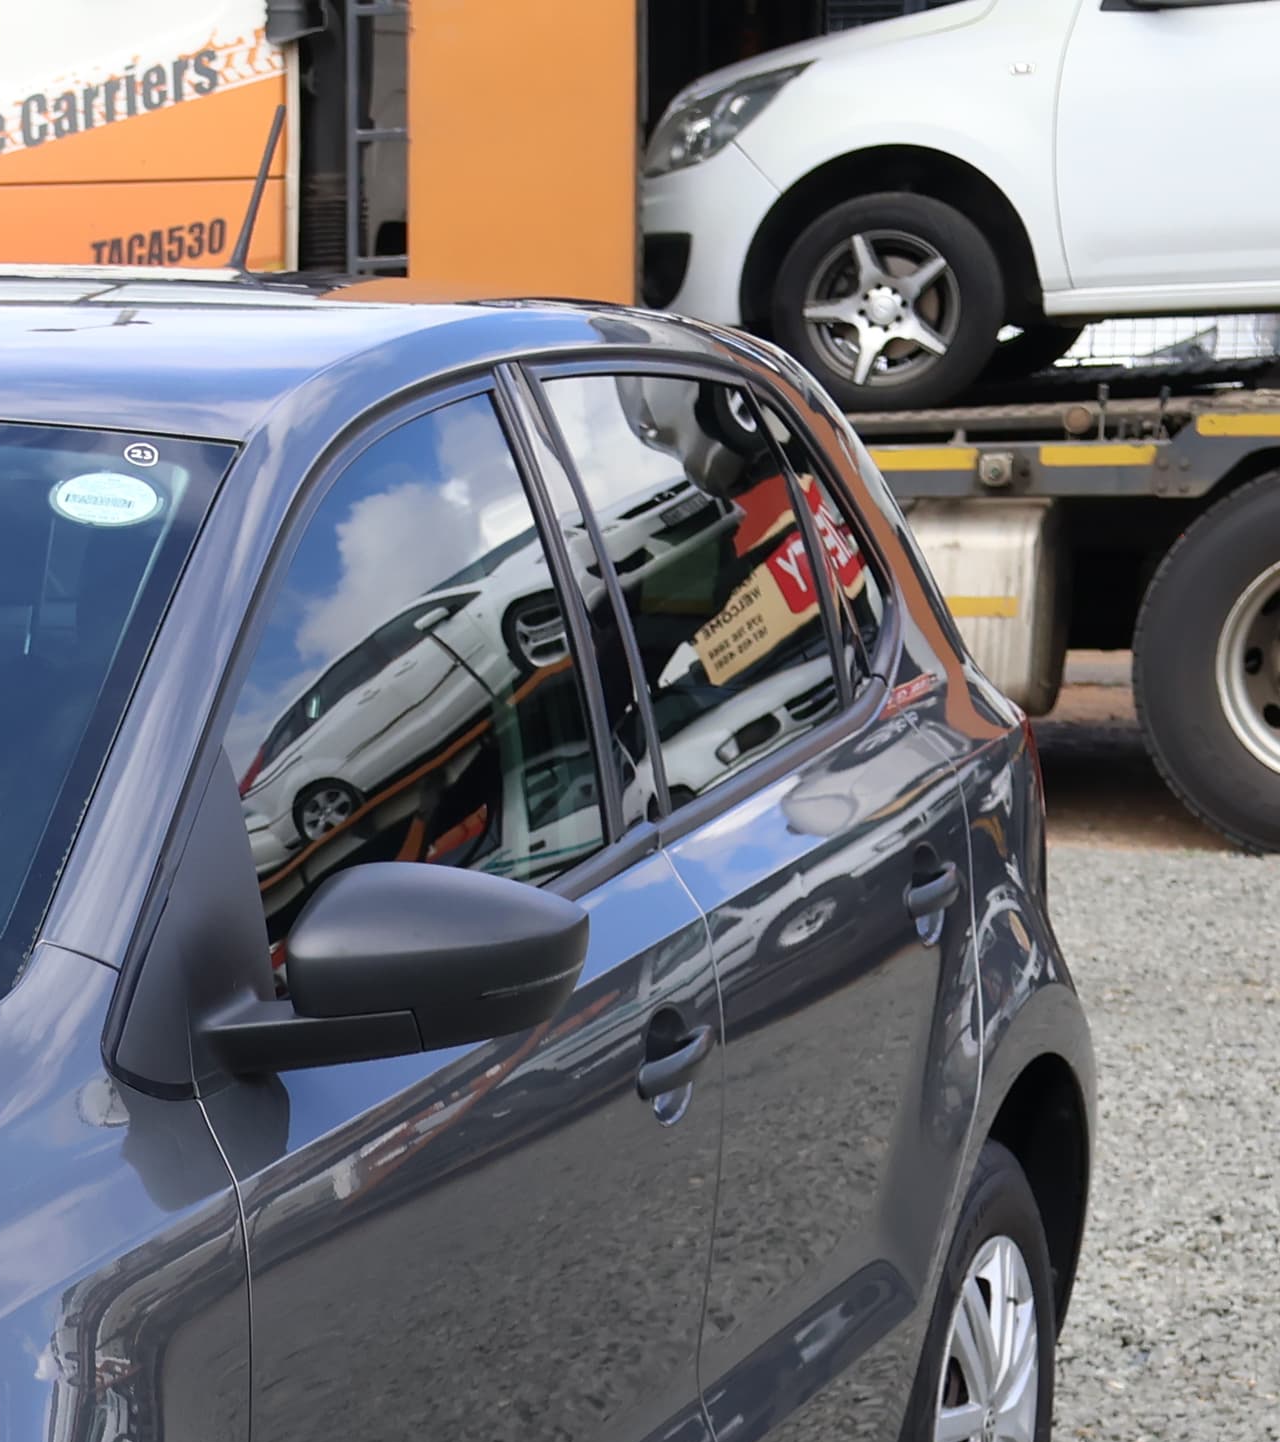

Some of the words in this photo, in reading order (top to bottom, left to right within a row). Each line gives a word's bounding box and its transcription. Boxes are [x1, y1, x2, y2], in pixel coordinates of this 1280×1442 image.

[21, 48, 219, 148] Carriers
[91, 218, 227, 265] TACA530
[130, 448, 153, 461] 23
